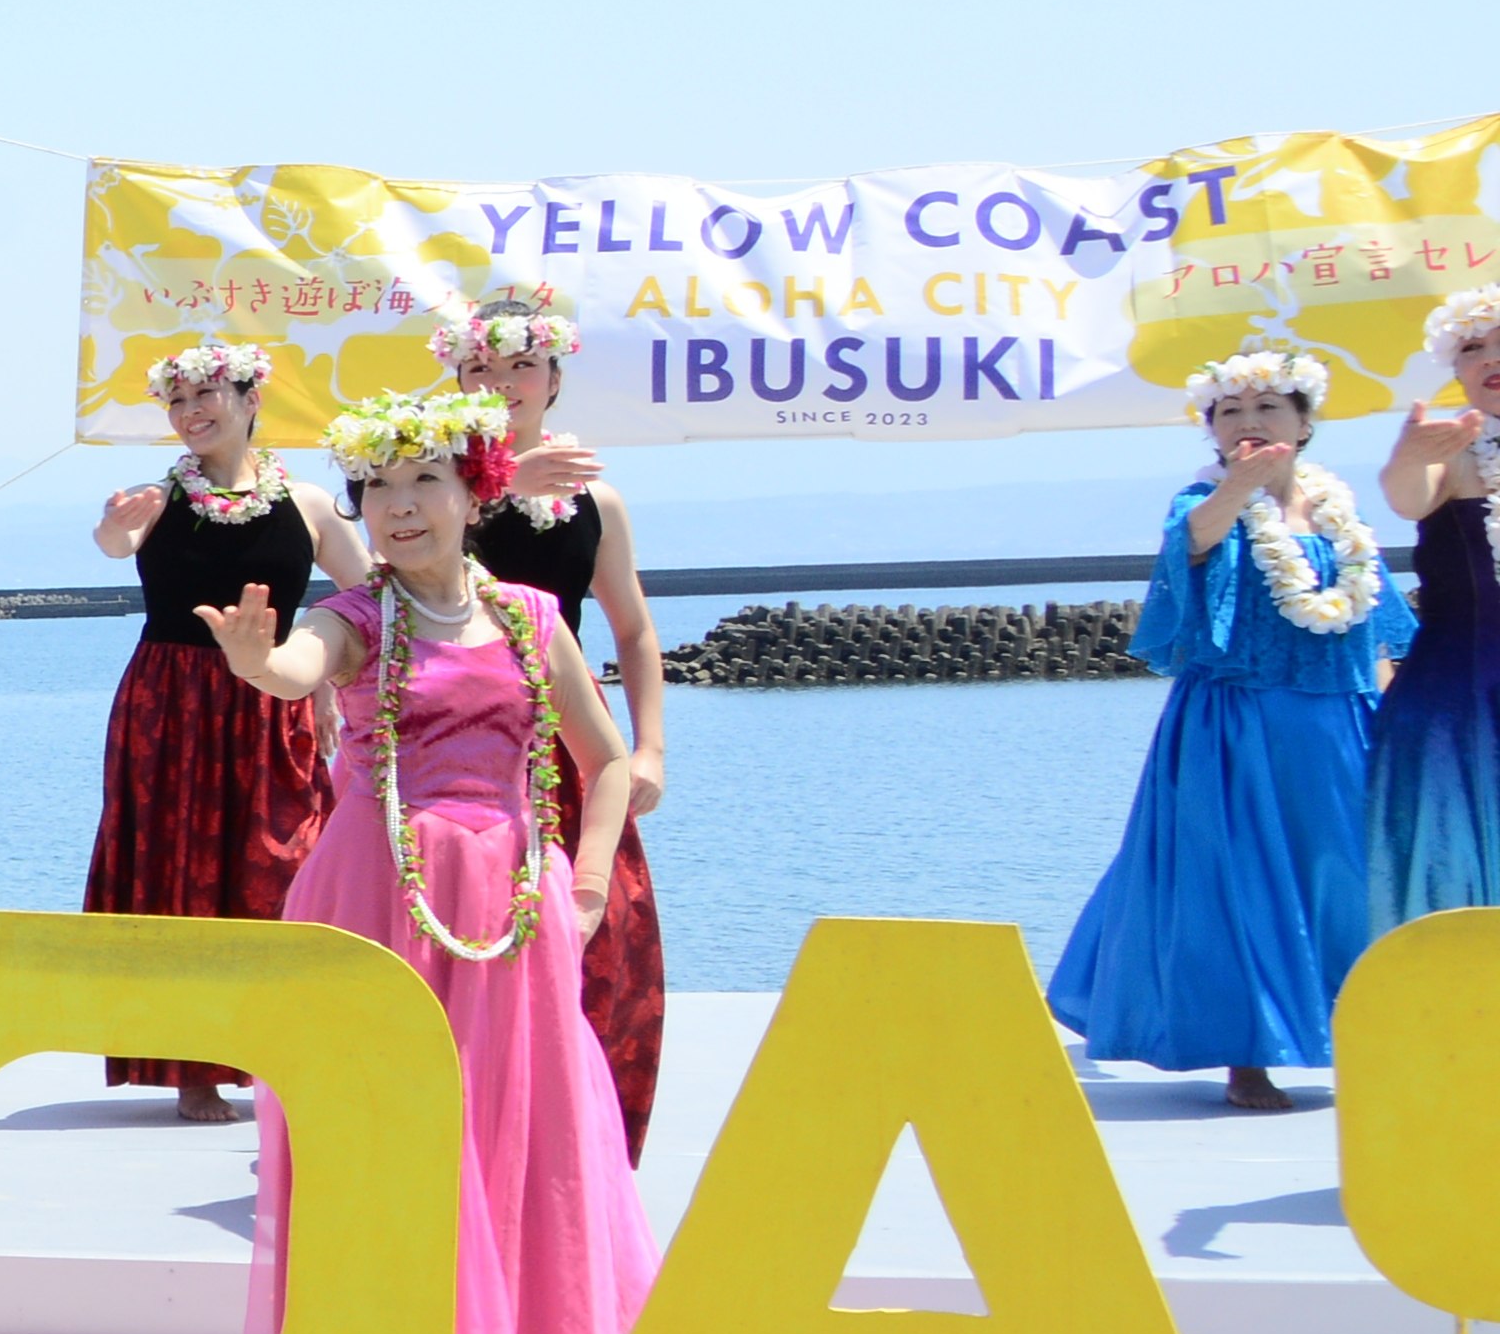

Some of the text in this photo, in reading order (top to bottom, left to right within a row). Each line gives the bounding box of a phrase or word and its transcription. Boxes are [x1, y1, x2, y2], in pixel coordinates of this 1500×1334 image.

[479, 165, 1238, 260] YELLOW COAST
[624, 272, 1079, 320] ALOHA CITY
[651, 335, 1057, 404] IBUSUKI
[775, 409, 929, 427] SINCE 2023
